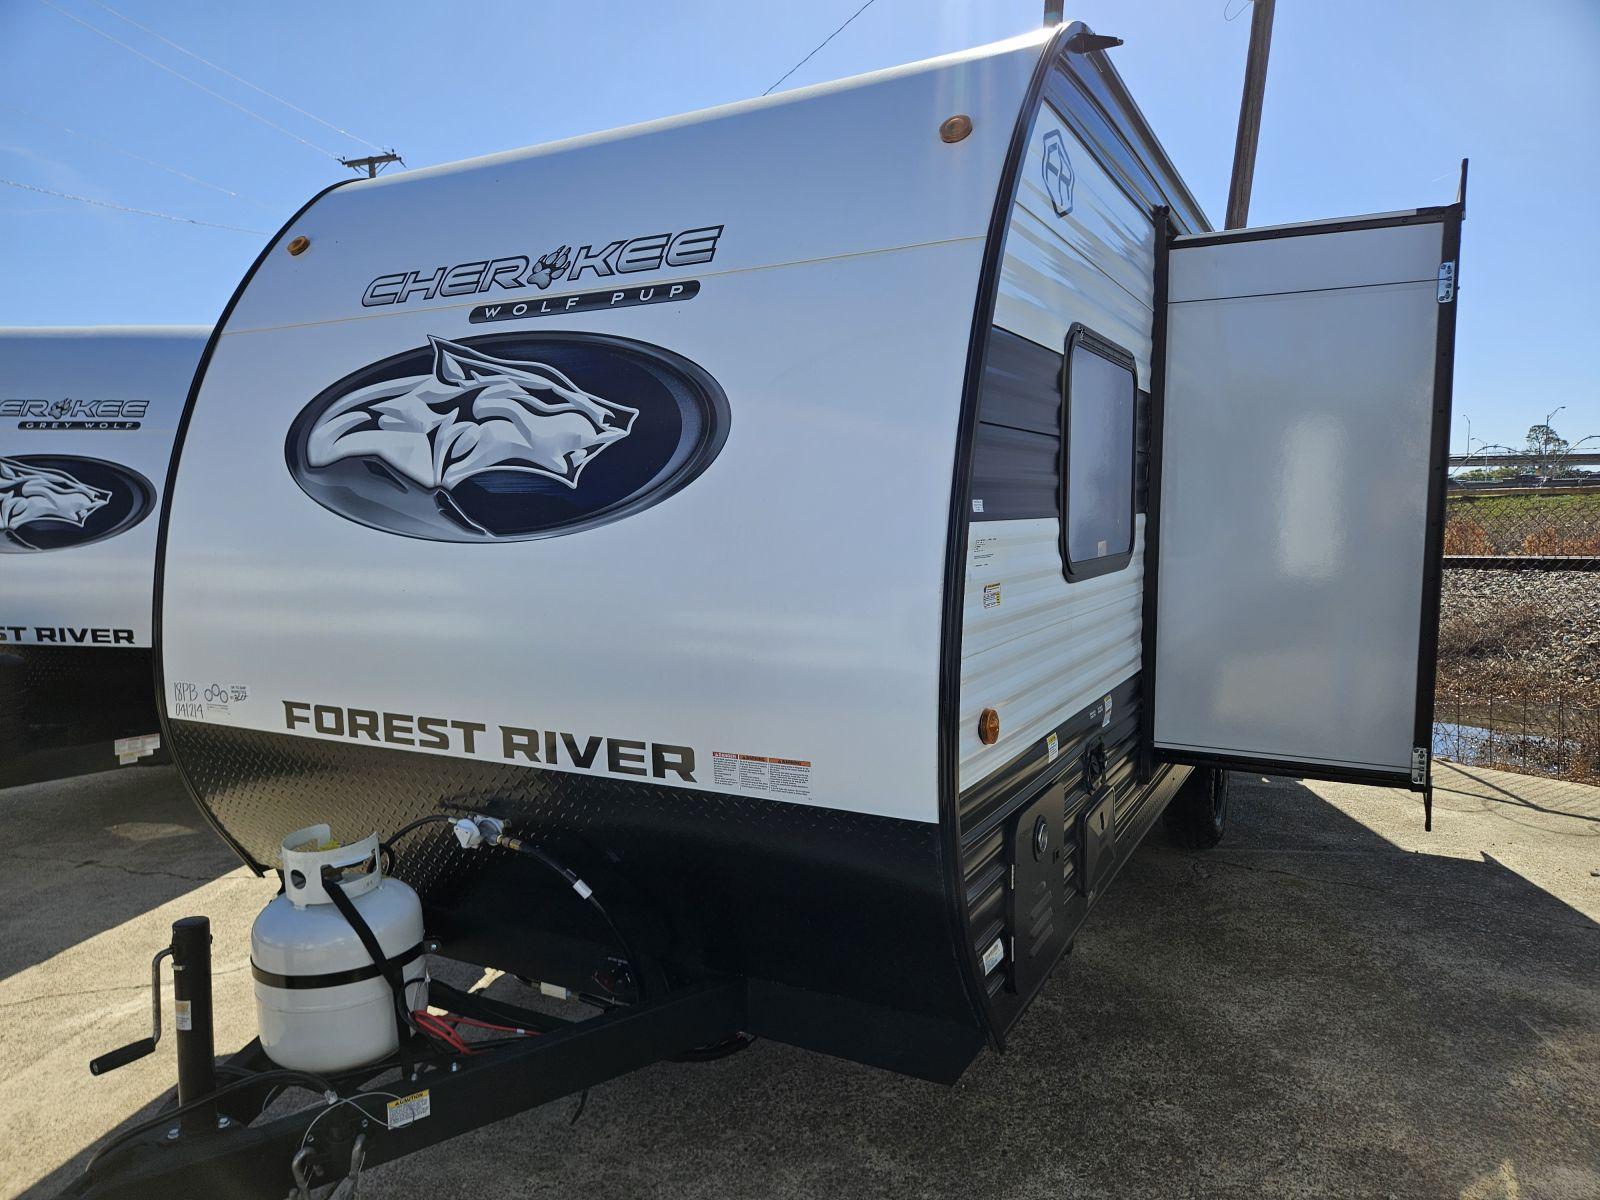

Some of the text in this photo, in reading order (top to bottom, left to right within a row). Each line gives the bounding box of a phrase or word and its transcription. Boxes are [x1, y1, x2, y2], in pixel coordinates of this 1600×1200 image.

[361, 224, 725, 307] CHEROKEE
[485, 284, 684, 319] WOLF PUP
[25, 422, 135, 430] GREY WOLF
[34, 626, 135, 645] RIVER
[282, 699, 487, 754] FOREST
[498, 724, 698, 784] RIVER
[399, 1092, 423, 1104] CAUTION
